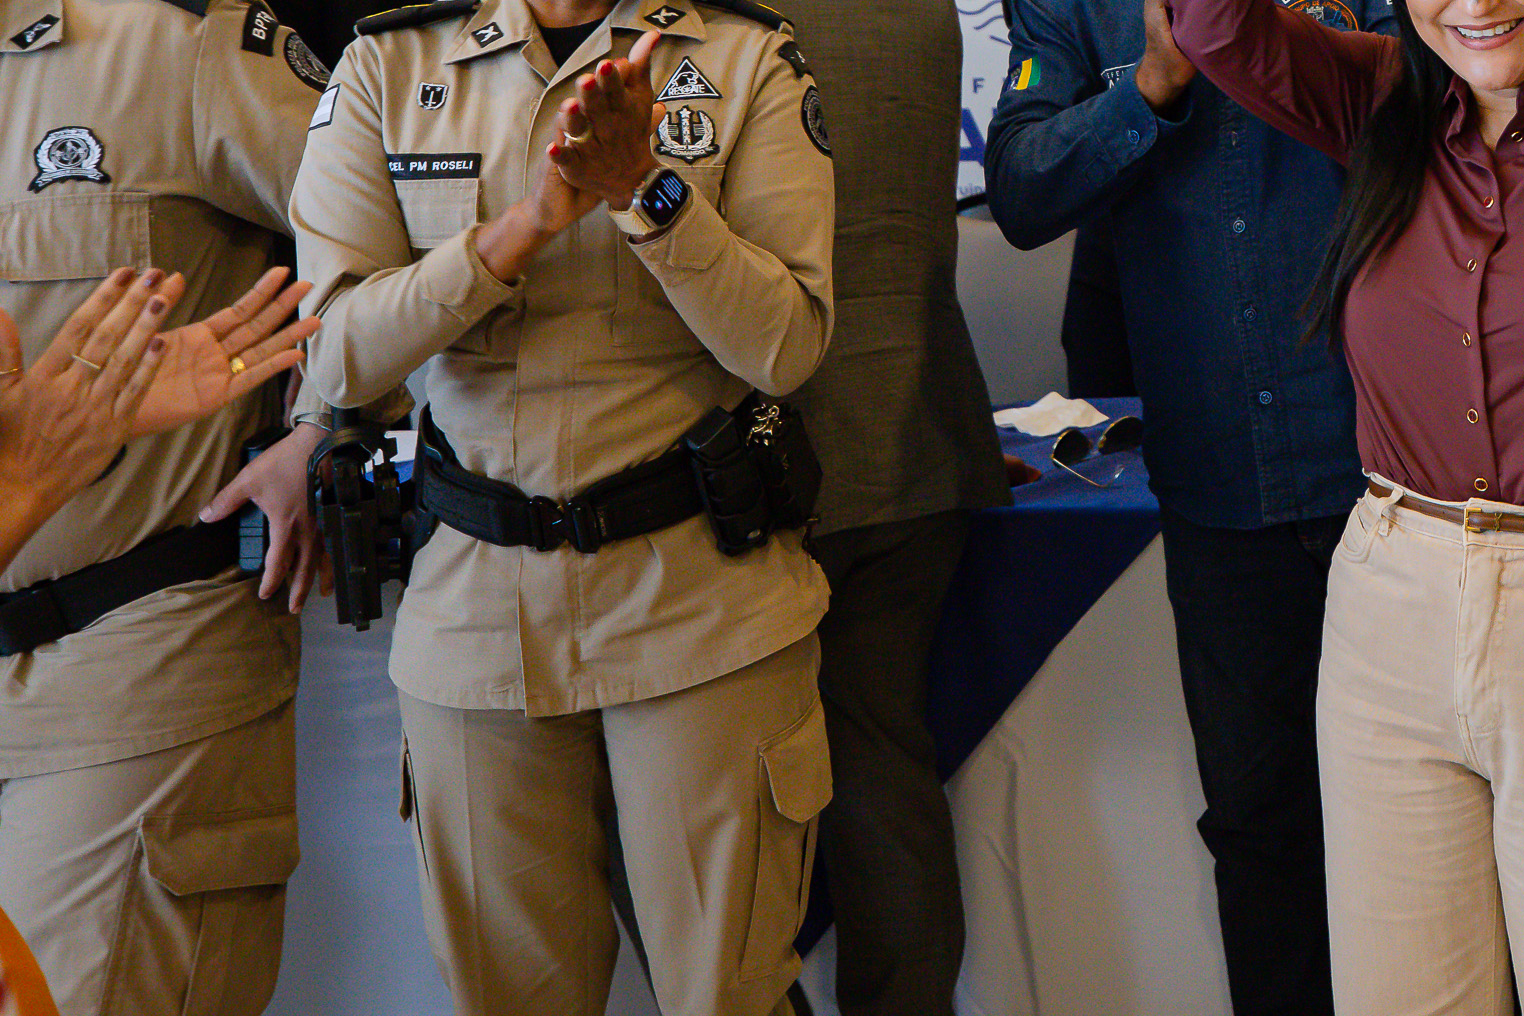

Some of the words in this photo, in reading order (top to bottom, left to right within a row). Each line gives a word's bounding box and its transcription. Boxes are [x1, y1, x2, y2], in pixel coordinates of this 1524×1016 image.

[667, 84, 706, 97] RESGATE
[388, 161, 405, 172] CEL
[409, 161, 428, 172] PM
[432, 160, 474, 171] ROSELI
